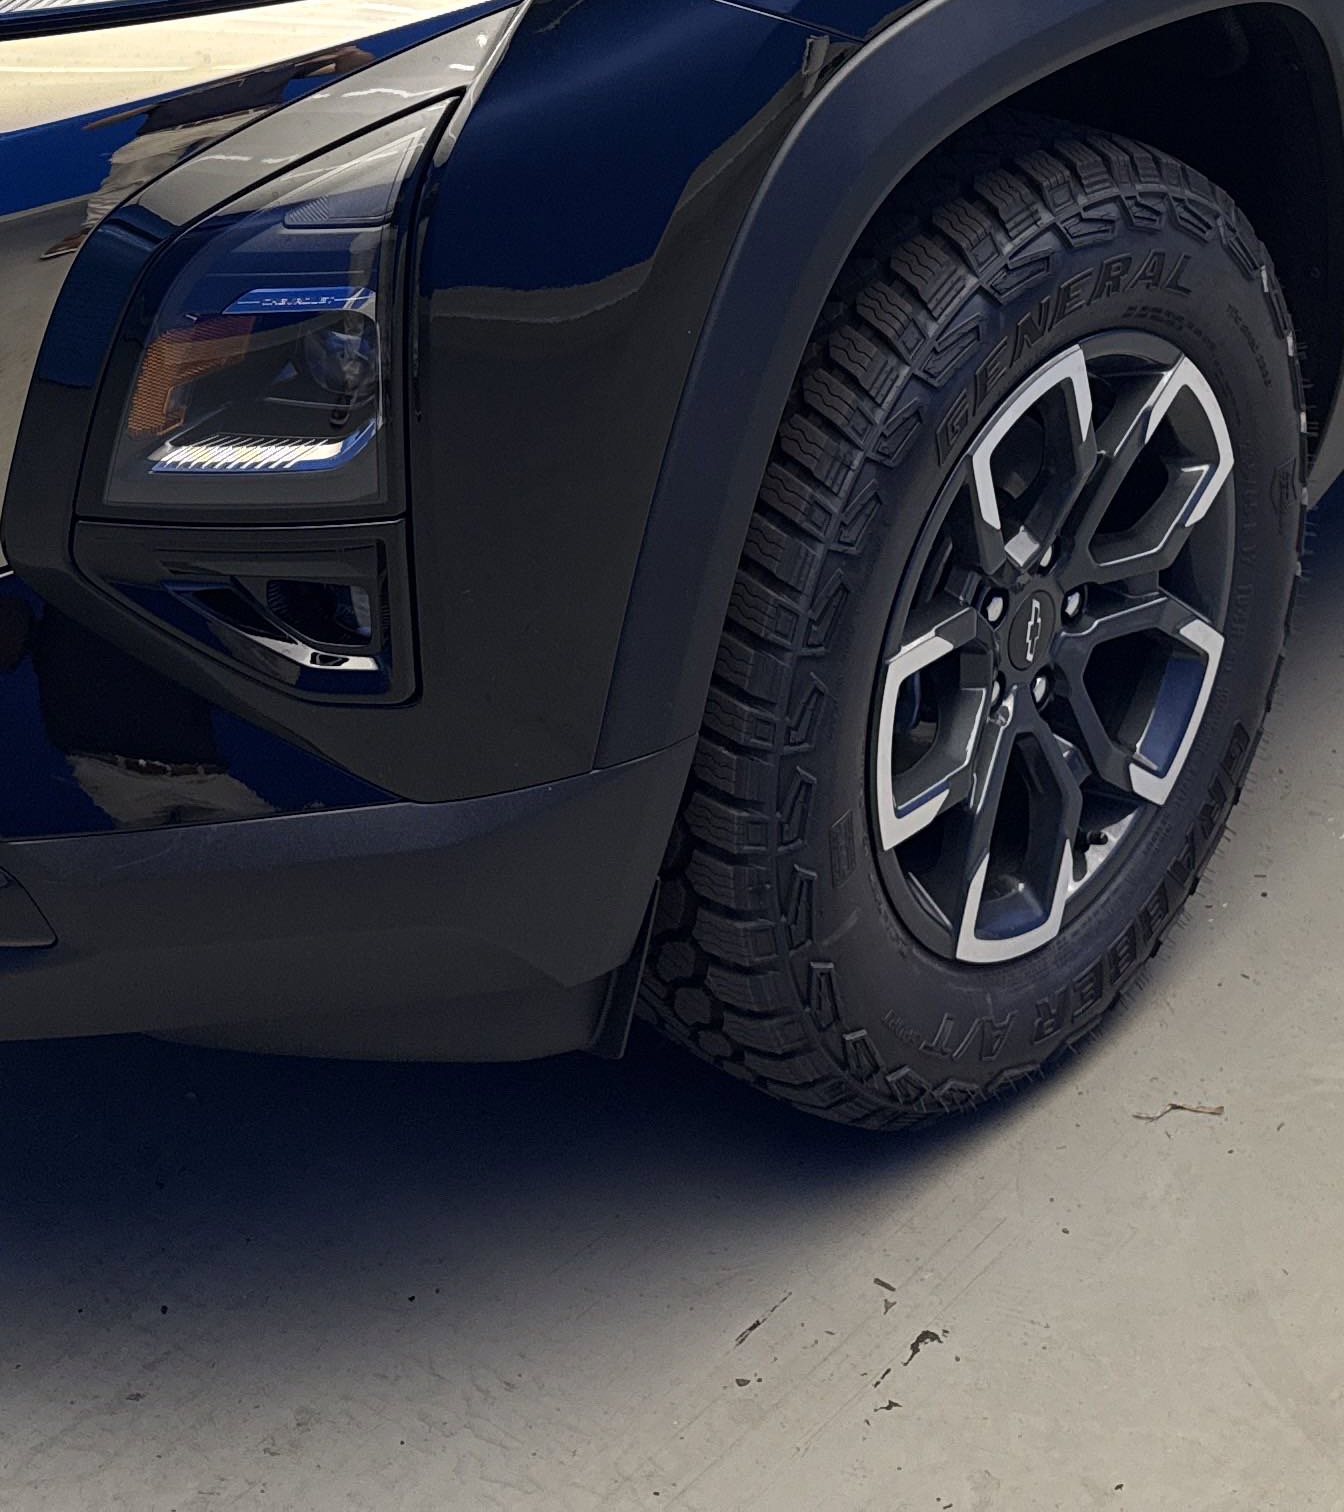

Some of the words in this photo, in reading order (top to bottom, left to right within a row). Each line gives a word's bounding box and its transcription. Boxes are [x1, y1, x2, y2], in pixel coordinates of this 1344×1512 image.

[936, 249, 1195, 466] GENERAL
[1033, 718, 1251, 1044] GRABBER
[920, 1011, 1019, 1062] A/T
